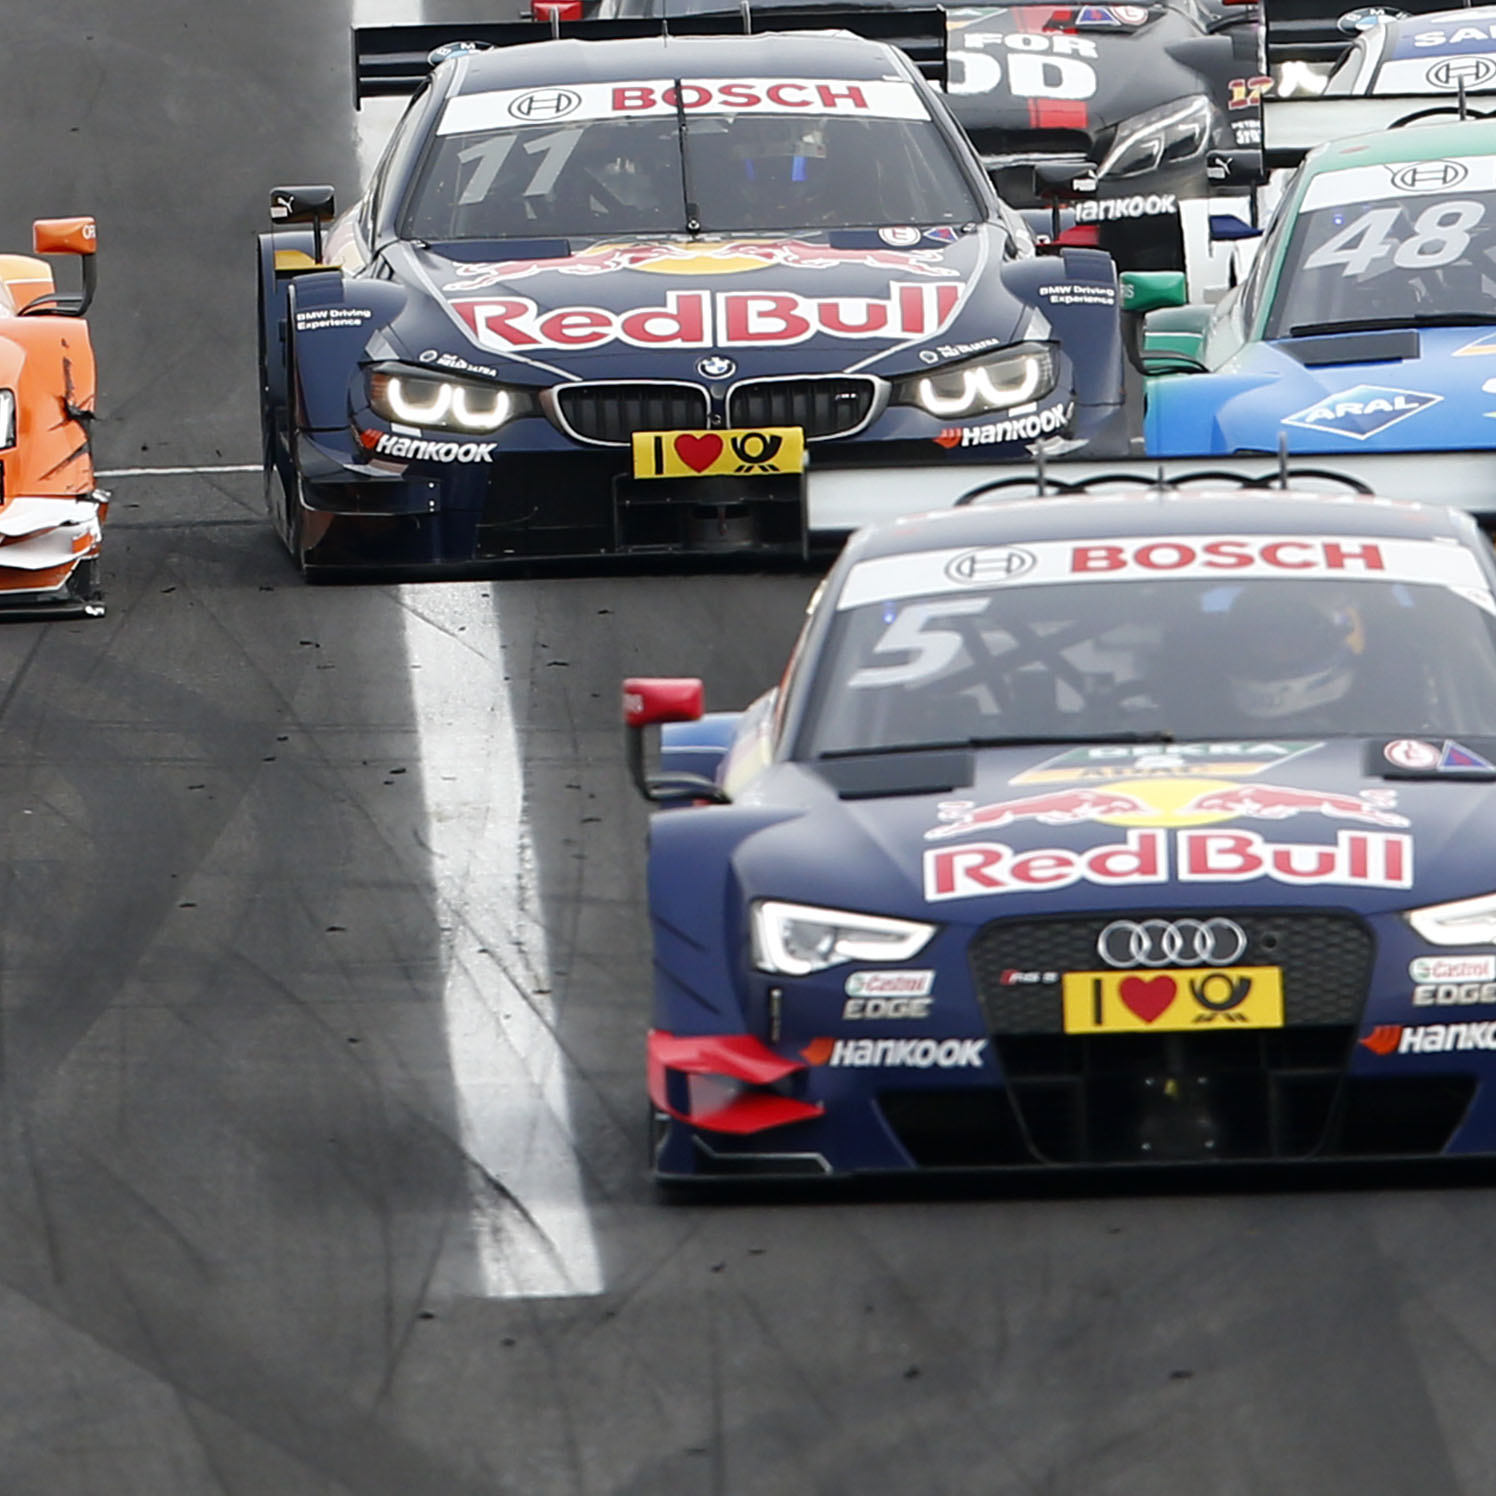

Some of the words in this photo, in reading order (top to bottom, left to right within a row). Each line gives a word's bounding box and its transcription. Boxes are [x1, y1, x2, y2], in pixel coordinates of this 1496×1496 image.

[963, 32, 1099, 59] FOR
[611, 82, 869, 112] BOSCH
[455, 128, 585, 206] 11
[1302, 200, 1487, 279] 48
[451, 290, 714, 351] Red
[717, 282, 966, 348] Bull
[1304, 395, 1422, 423] ARAL
[653, 435, 664, 476] I
[1069, 540, 1386, 574] BOSCH
[847, 597, 994, 689] 5
[924, 828, 1168, 901] Red
[1177, 828, 1415, 889] Bull
[1432, 960, 1491, 980] Castrol
[842, 997, 936, 1020] EDGE
[1093, 978, 1104, 1026] I
